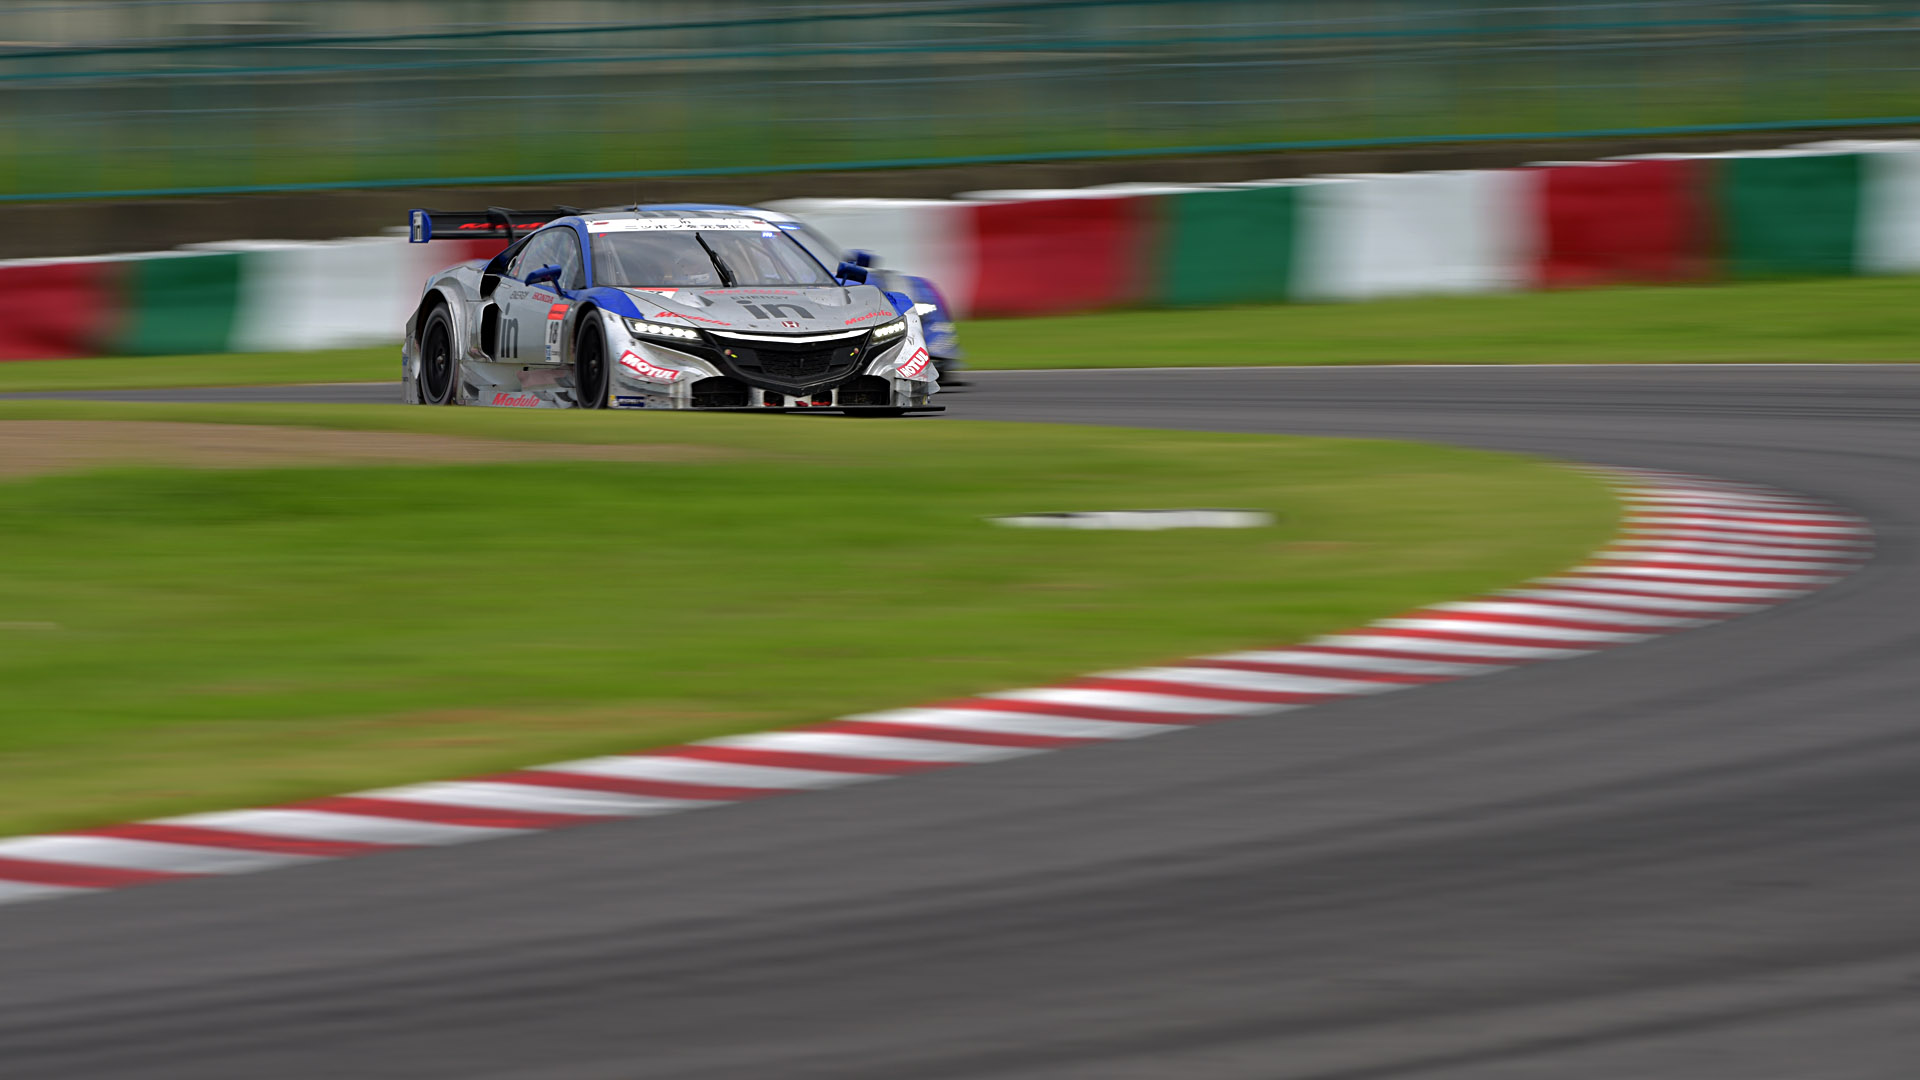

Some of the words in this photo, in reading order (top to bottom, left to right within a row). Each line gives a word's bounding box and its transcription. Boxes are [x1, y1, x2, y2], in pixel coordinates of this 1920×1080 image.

[654, 311, 732, 326] Modulo
[736, 300, 815, 320] in
[844, 309, 893, 326] Modulo
[501, 302, 518, 358] in
[621, 353, 674, 380] MOTUL
[899, 350, 929, 378] MOTUL
[492, 392, 540, 407] Modulo
